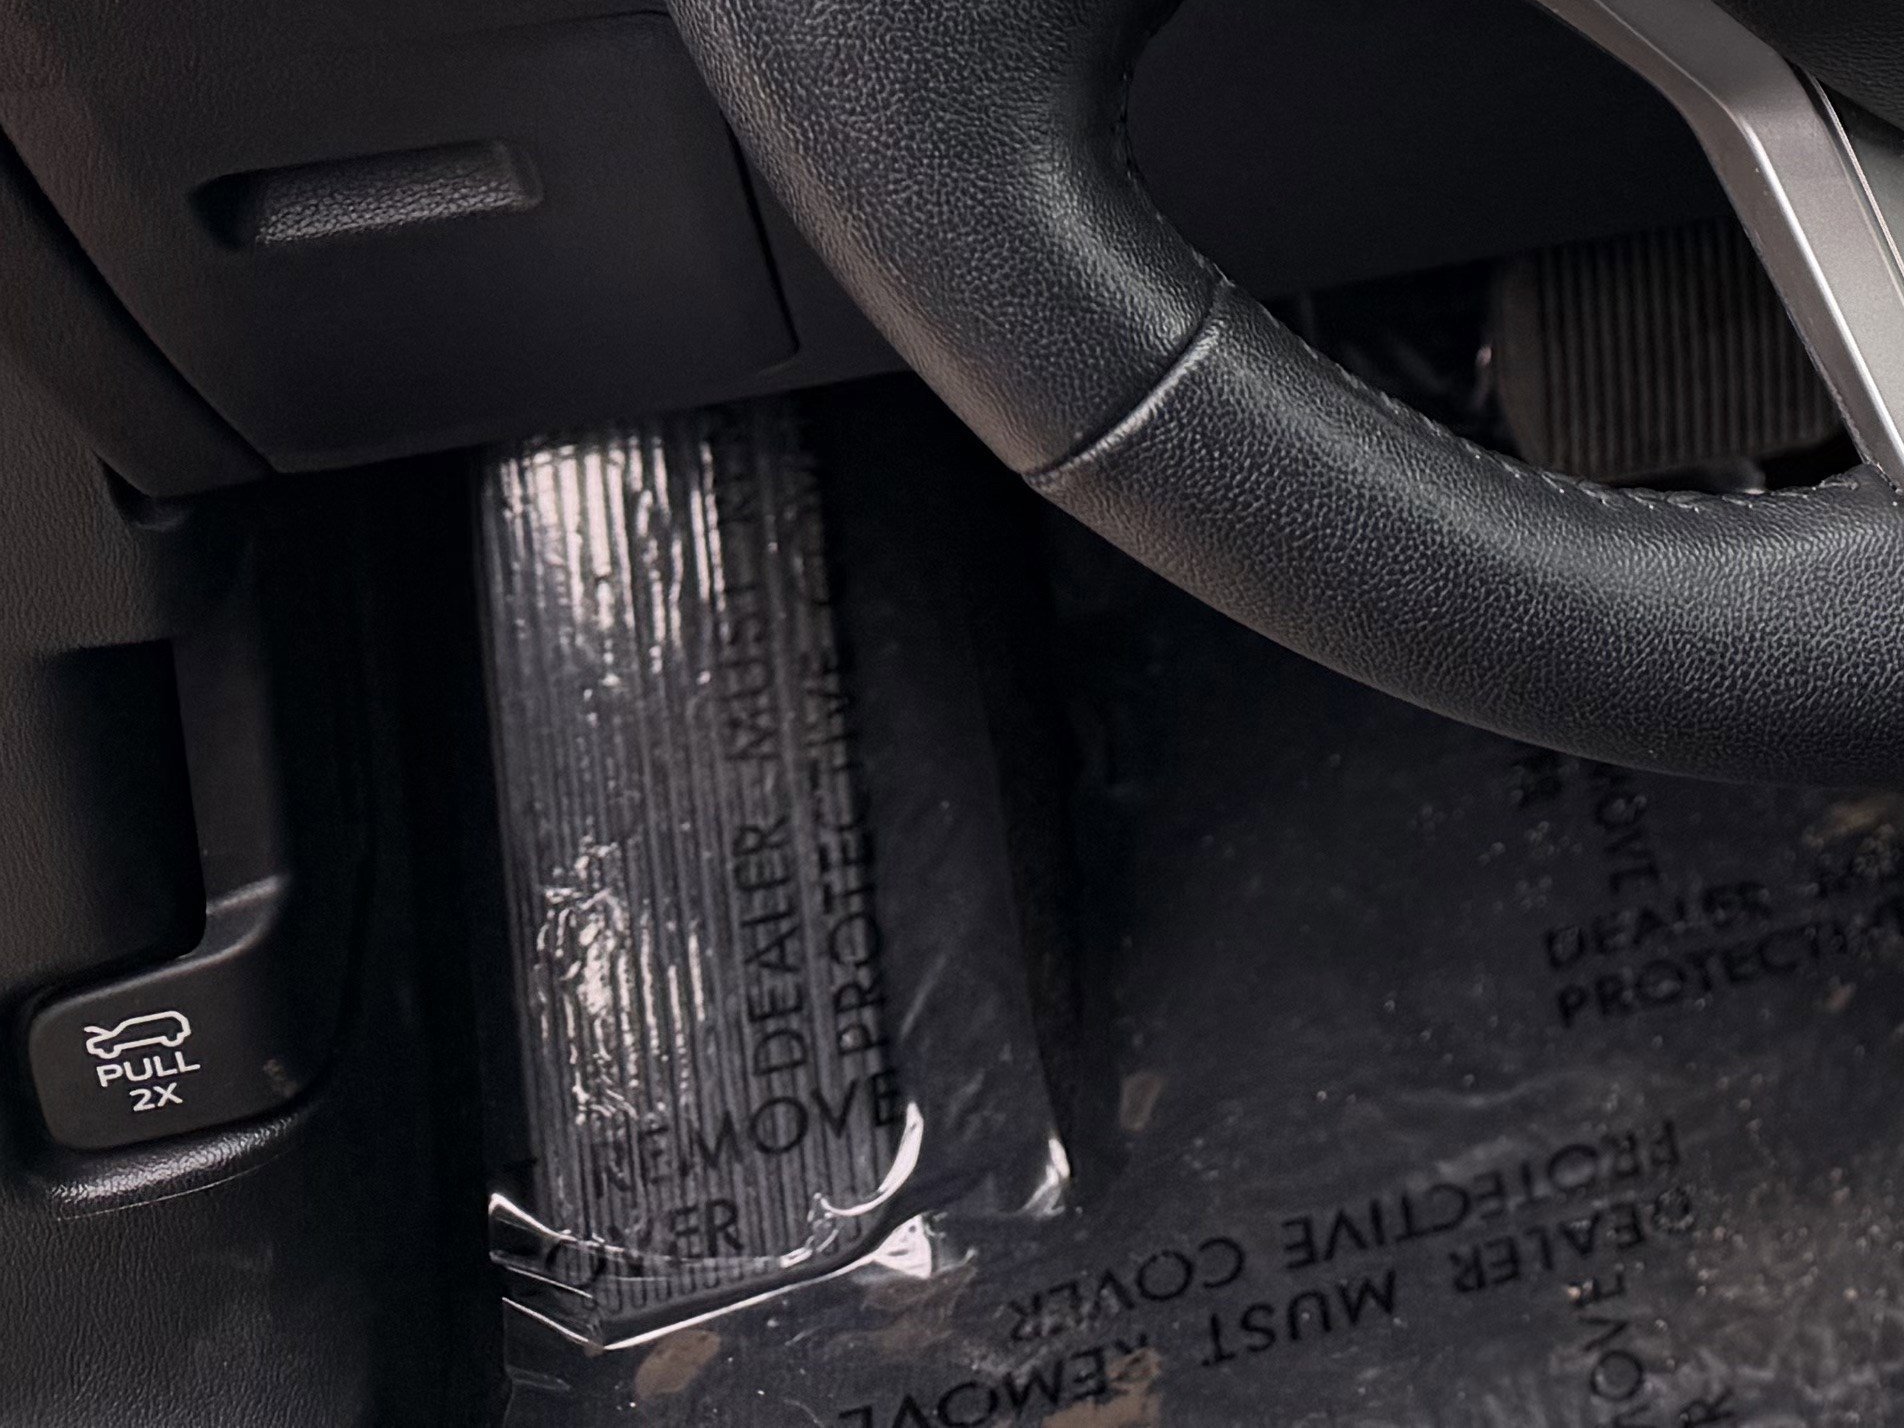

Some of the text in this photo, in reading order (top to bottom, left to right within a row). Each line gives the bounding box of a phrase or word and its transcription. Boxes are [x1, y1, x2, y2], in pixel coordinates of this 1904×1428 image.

[96, 1052, 199, 1088] PULL
[131, 1082, 183, 1112] 2X
[1283, 1118, 1683, 1274] PROTECTIVE
[1202, 1269, 1398, 1368] MUST
